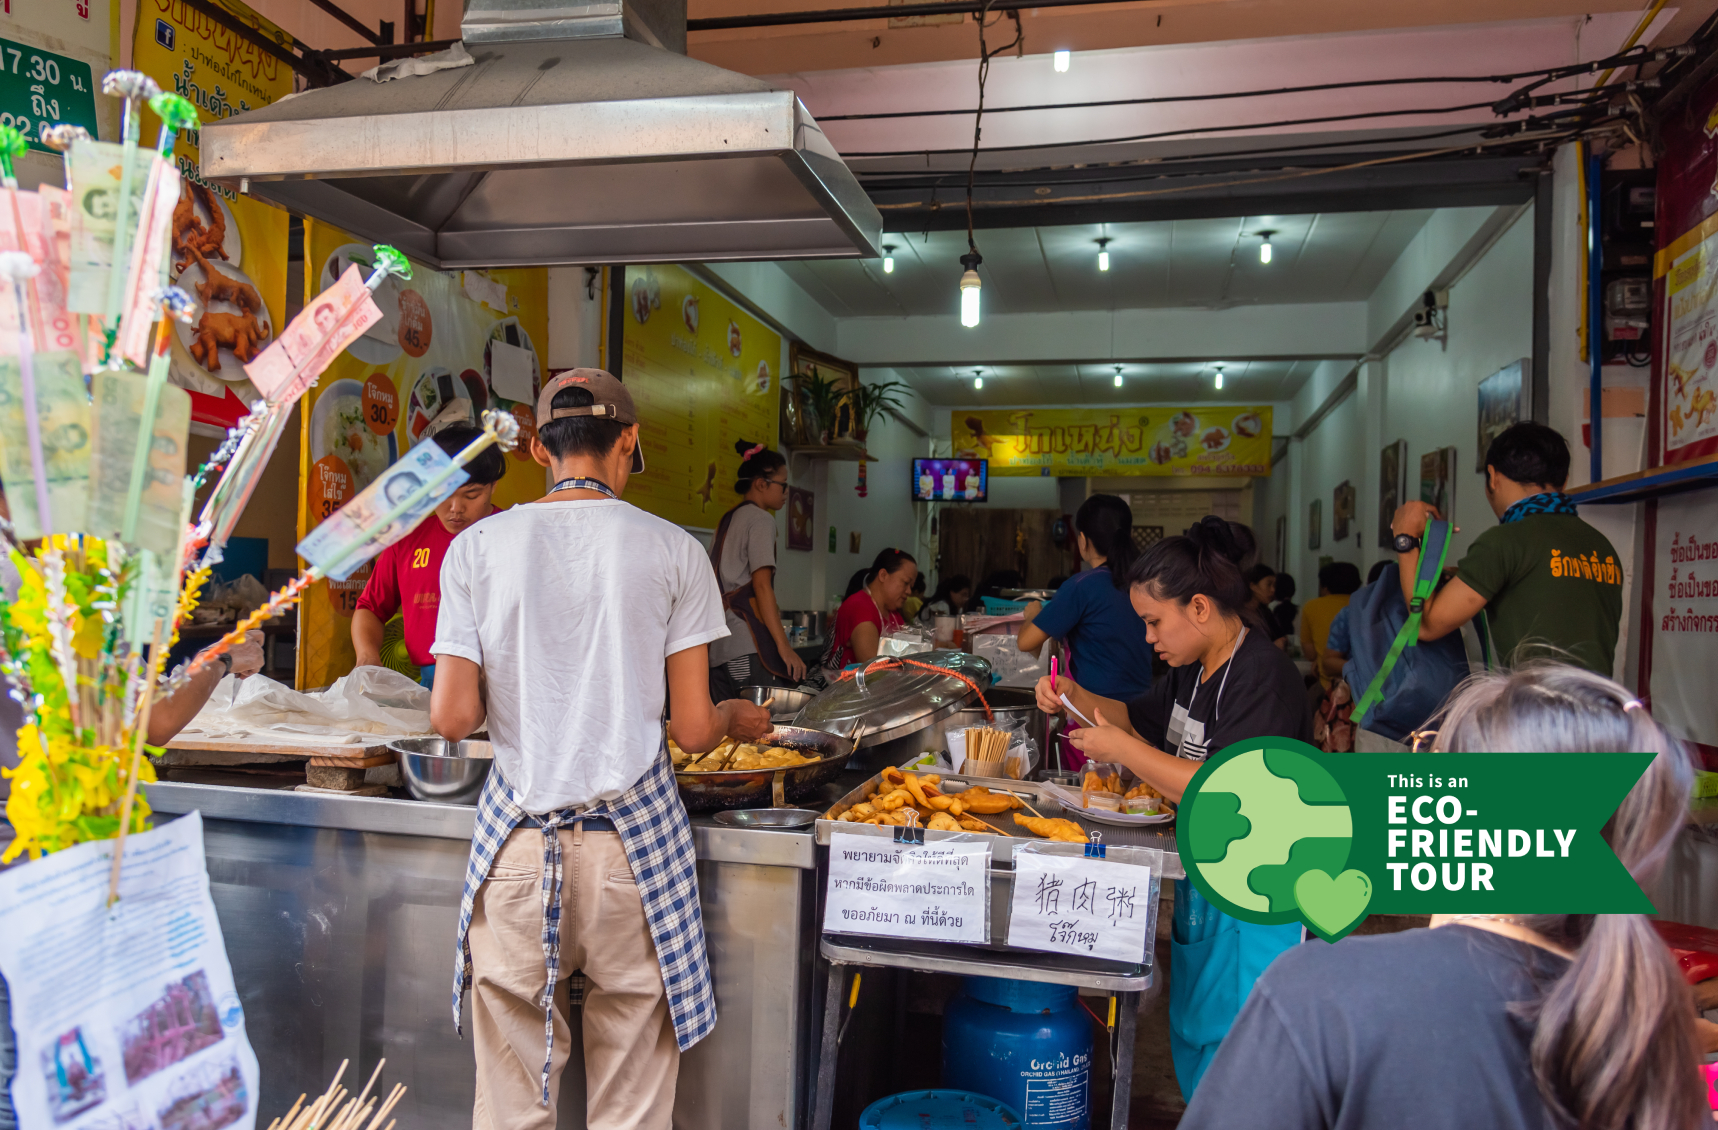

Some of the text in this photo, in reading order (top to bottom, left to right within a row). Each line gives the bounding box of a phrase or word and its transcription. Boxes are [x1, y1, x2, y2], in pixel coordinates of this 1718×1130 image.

[0, 45, 88, 93] 17.30 น.
[30, 84, 60, 120] ถึง
[367, 382, 393, 409] โจ๊กหมู
[370, 404, 396, 425] 30.-
[412, 548, 430, 568] 20
[339, 590, 357, 611] 15
[834, 876, 975, 896] หากมีข้อผิดพลาดประการใด
[842, 905, 963, 928] ขออภัยมา ณ ที่นี้ด้วย
[1049, 919, 1099, 951] โจ๊กหมู
